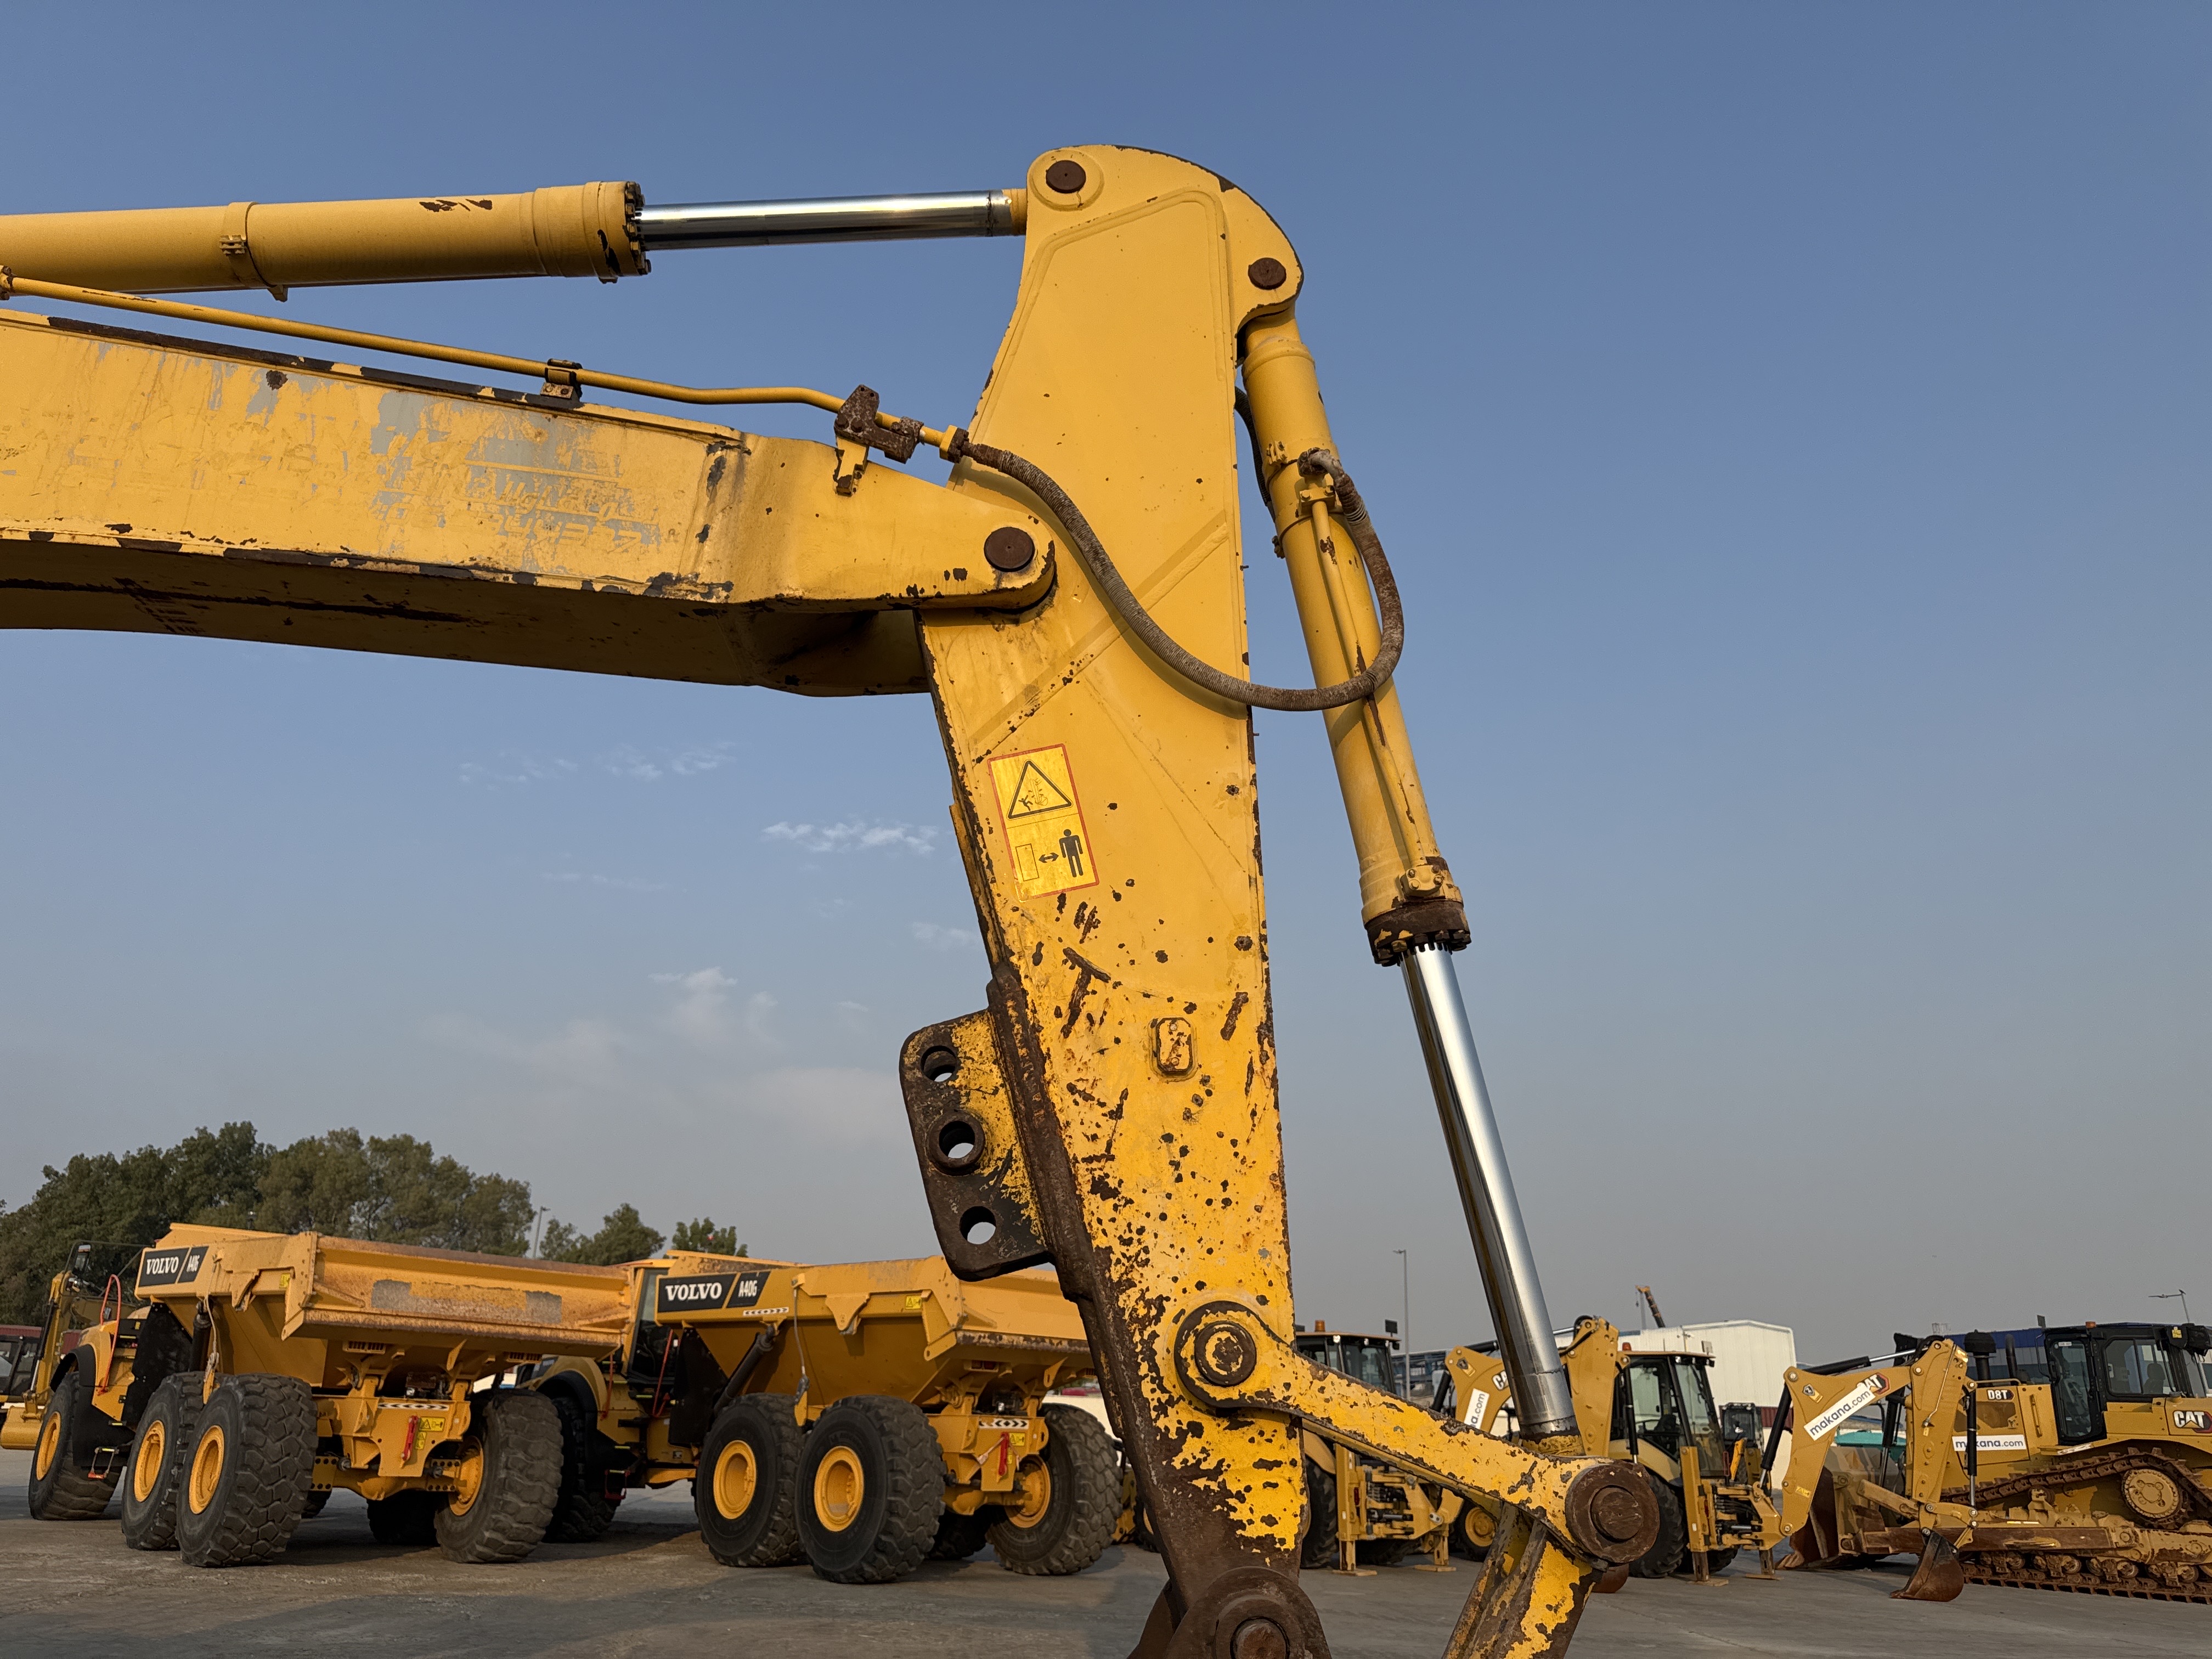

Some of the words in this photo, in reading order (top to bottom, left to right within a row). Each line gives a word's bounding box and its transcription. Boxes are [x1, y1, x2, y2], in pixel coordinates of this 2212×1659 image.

[146, 1256, 179, 1275] VOLVO
[665, 1282, 722, 1301] VOLVO
[738, 1280, 758, 1298] A40G
[1492, 1370, 1509, 1390] CA
[1987, 1389, 2008, 1400] D8T
[1809, 1390, 1871, 1436] makana.com
[2174, 1410, 2205, 1429] CAT
